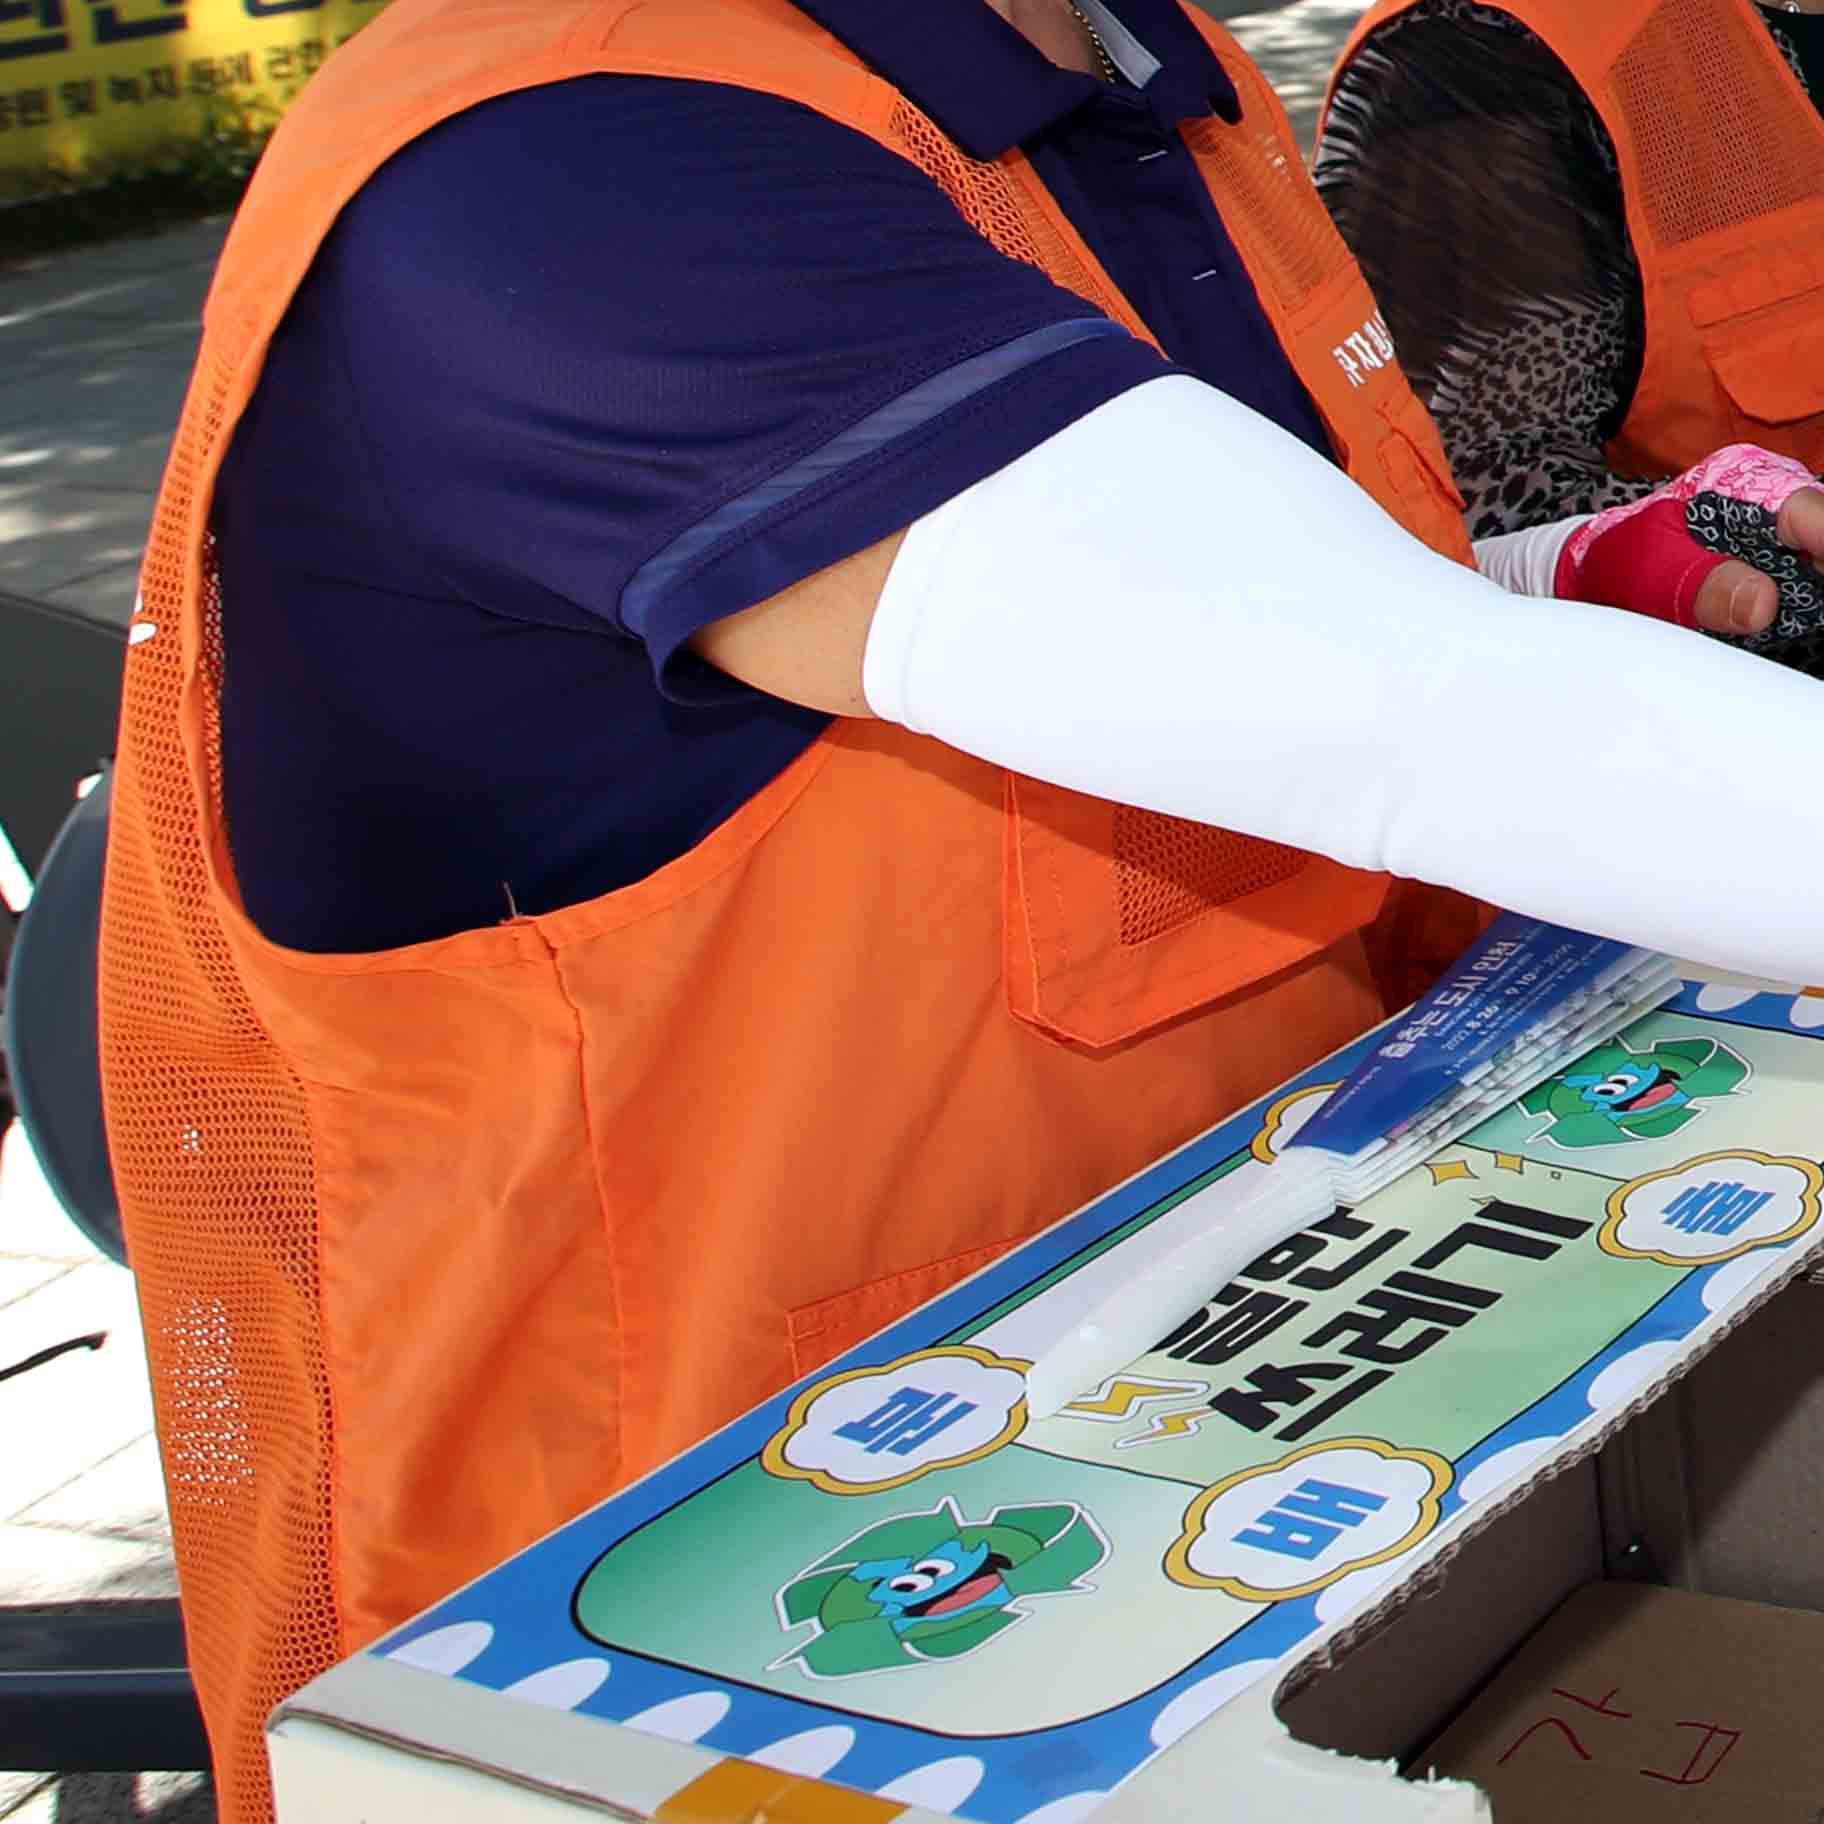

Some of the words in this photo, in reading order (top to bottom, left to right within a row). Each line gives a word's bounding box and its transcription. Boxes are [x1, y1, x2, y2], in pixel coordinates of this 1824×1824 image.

[1212, 1199, 1592, 1443] 쓰레기
[836, 1386, 978, 1457] 분
[1233, 1480, 1386, 1562] 배
